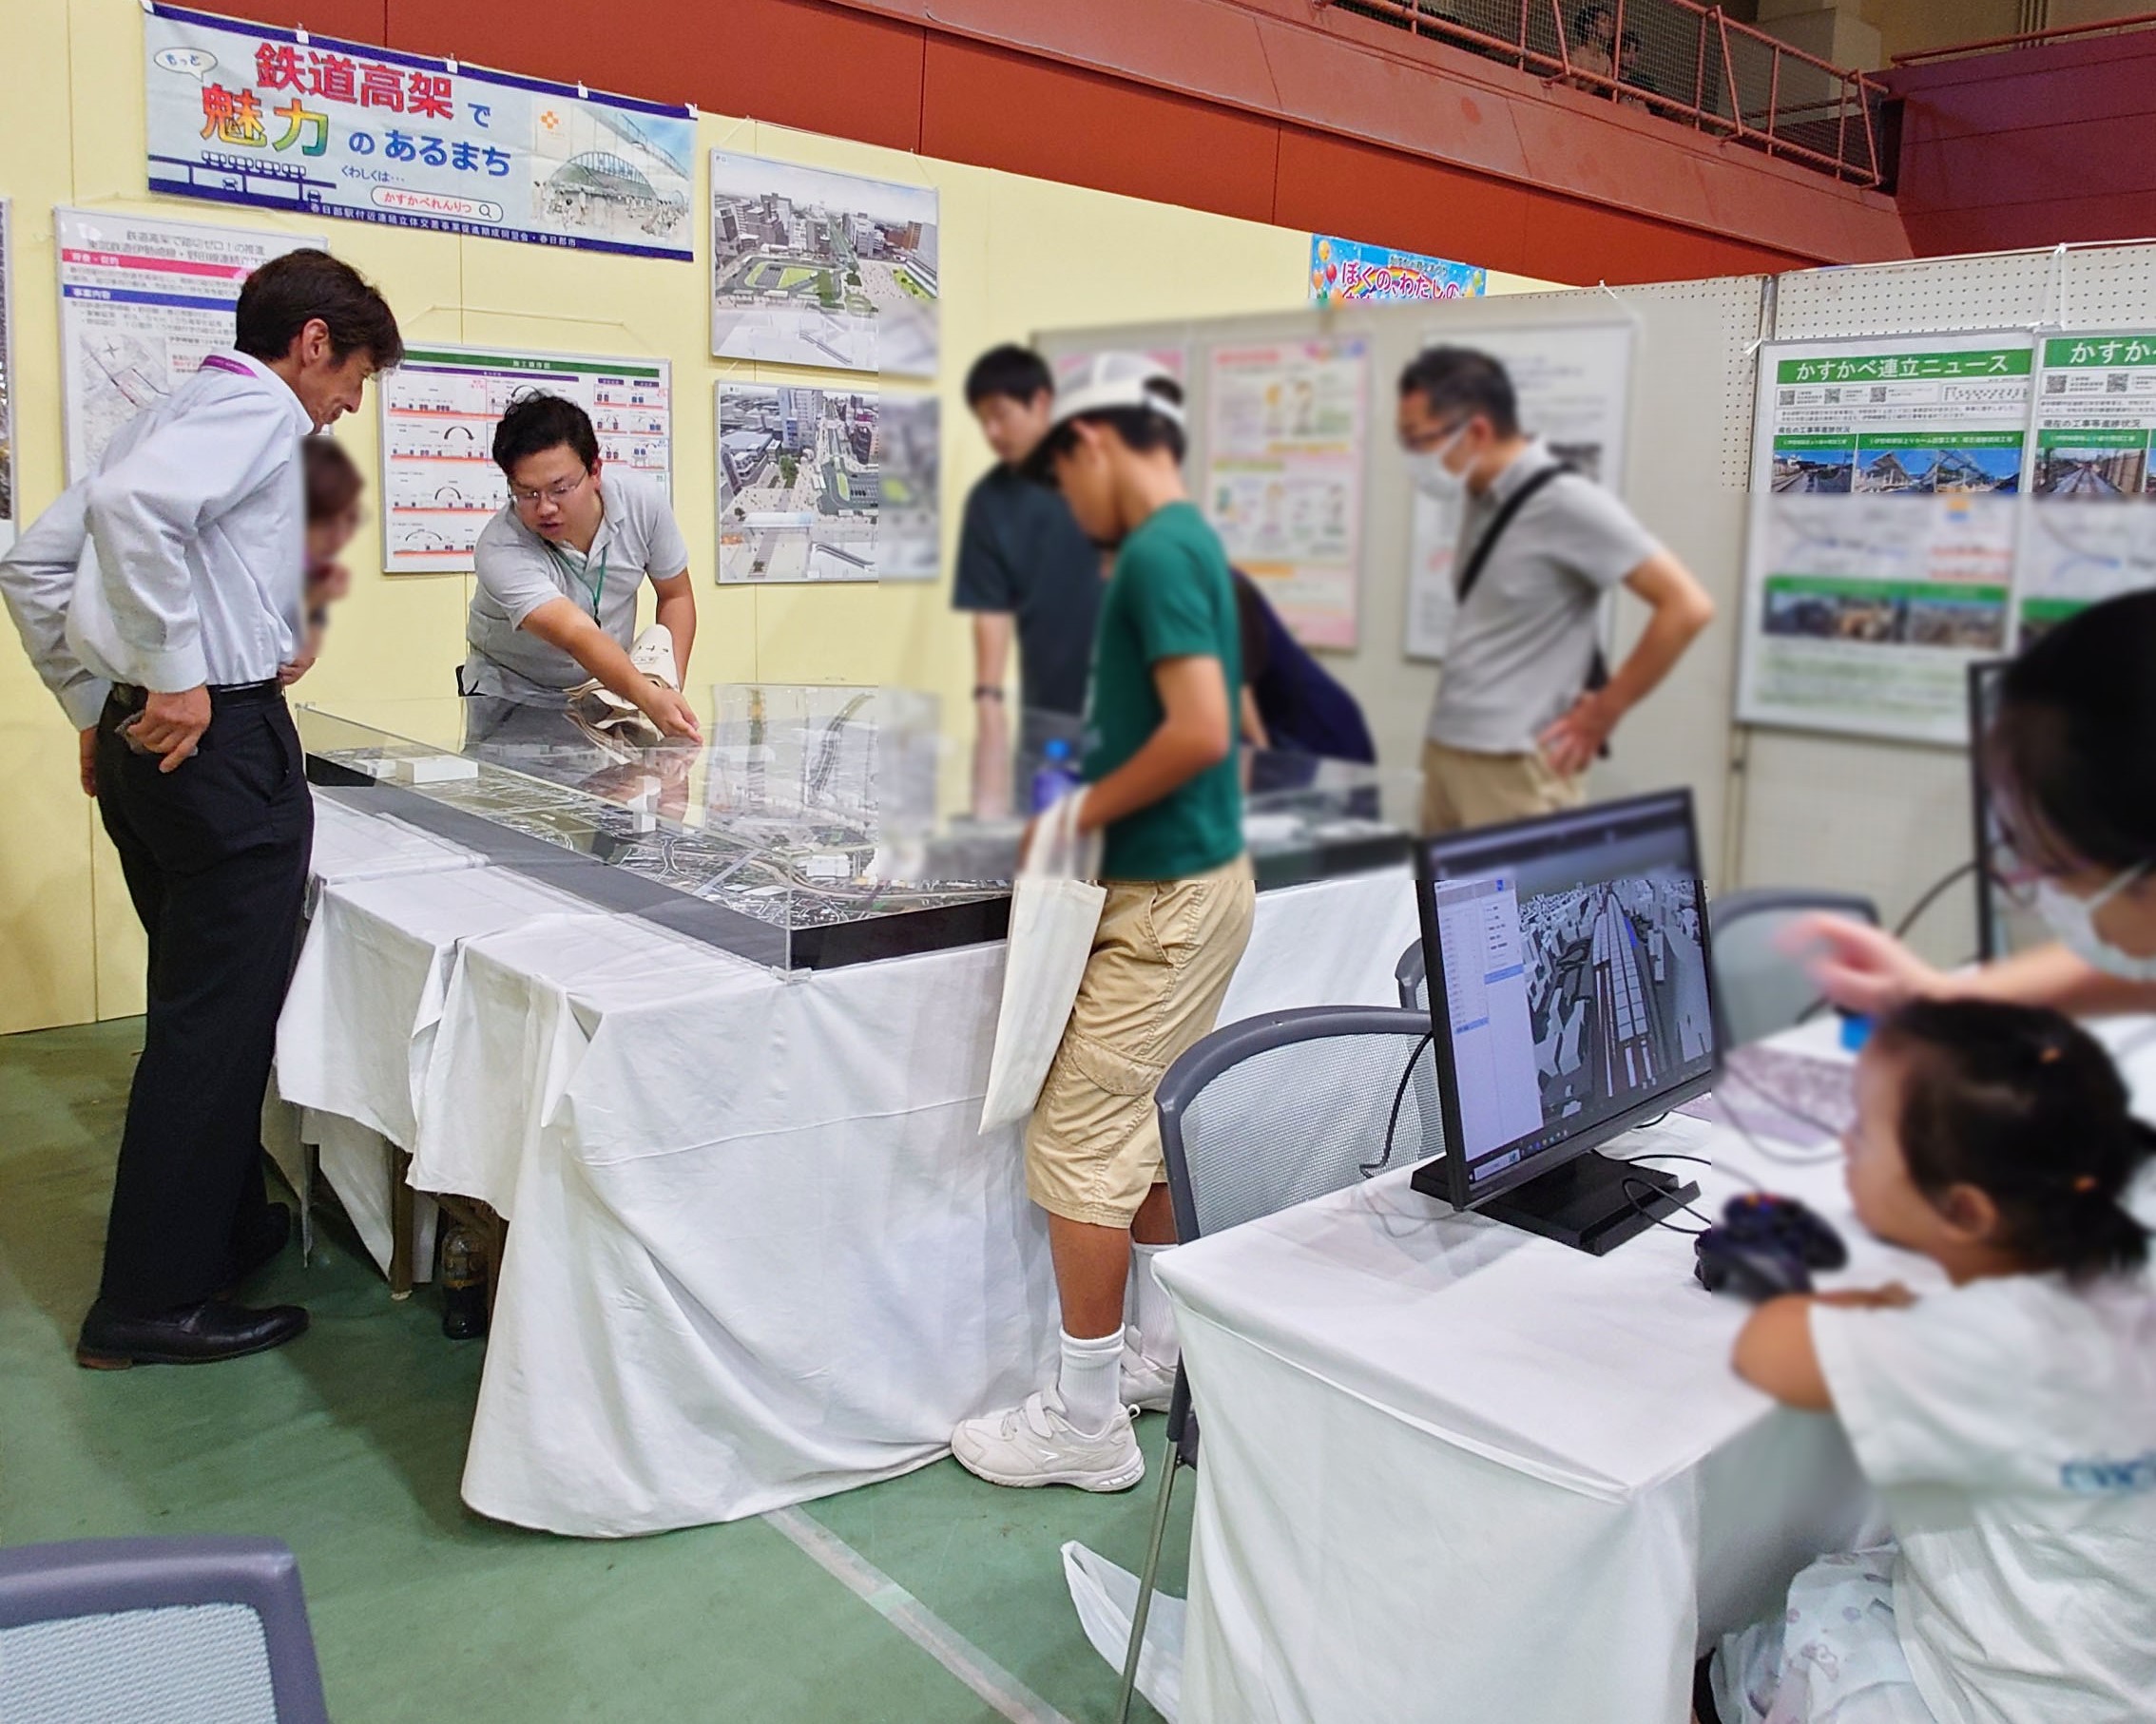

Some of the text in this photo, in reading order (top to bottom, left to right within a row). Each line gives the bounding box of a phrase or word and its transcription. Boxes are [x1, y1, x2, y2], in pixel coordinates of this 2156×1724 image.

[165, 52, 202, 67] もっと
[384, 192, 472, 214] かすかべれんりつ
[2069, 340, 2156, 364] かすか
[1796, 354, 2009, 381] かすかべ連立ニュース
